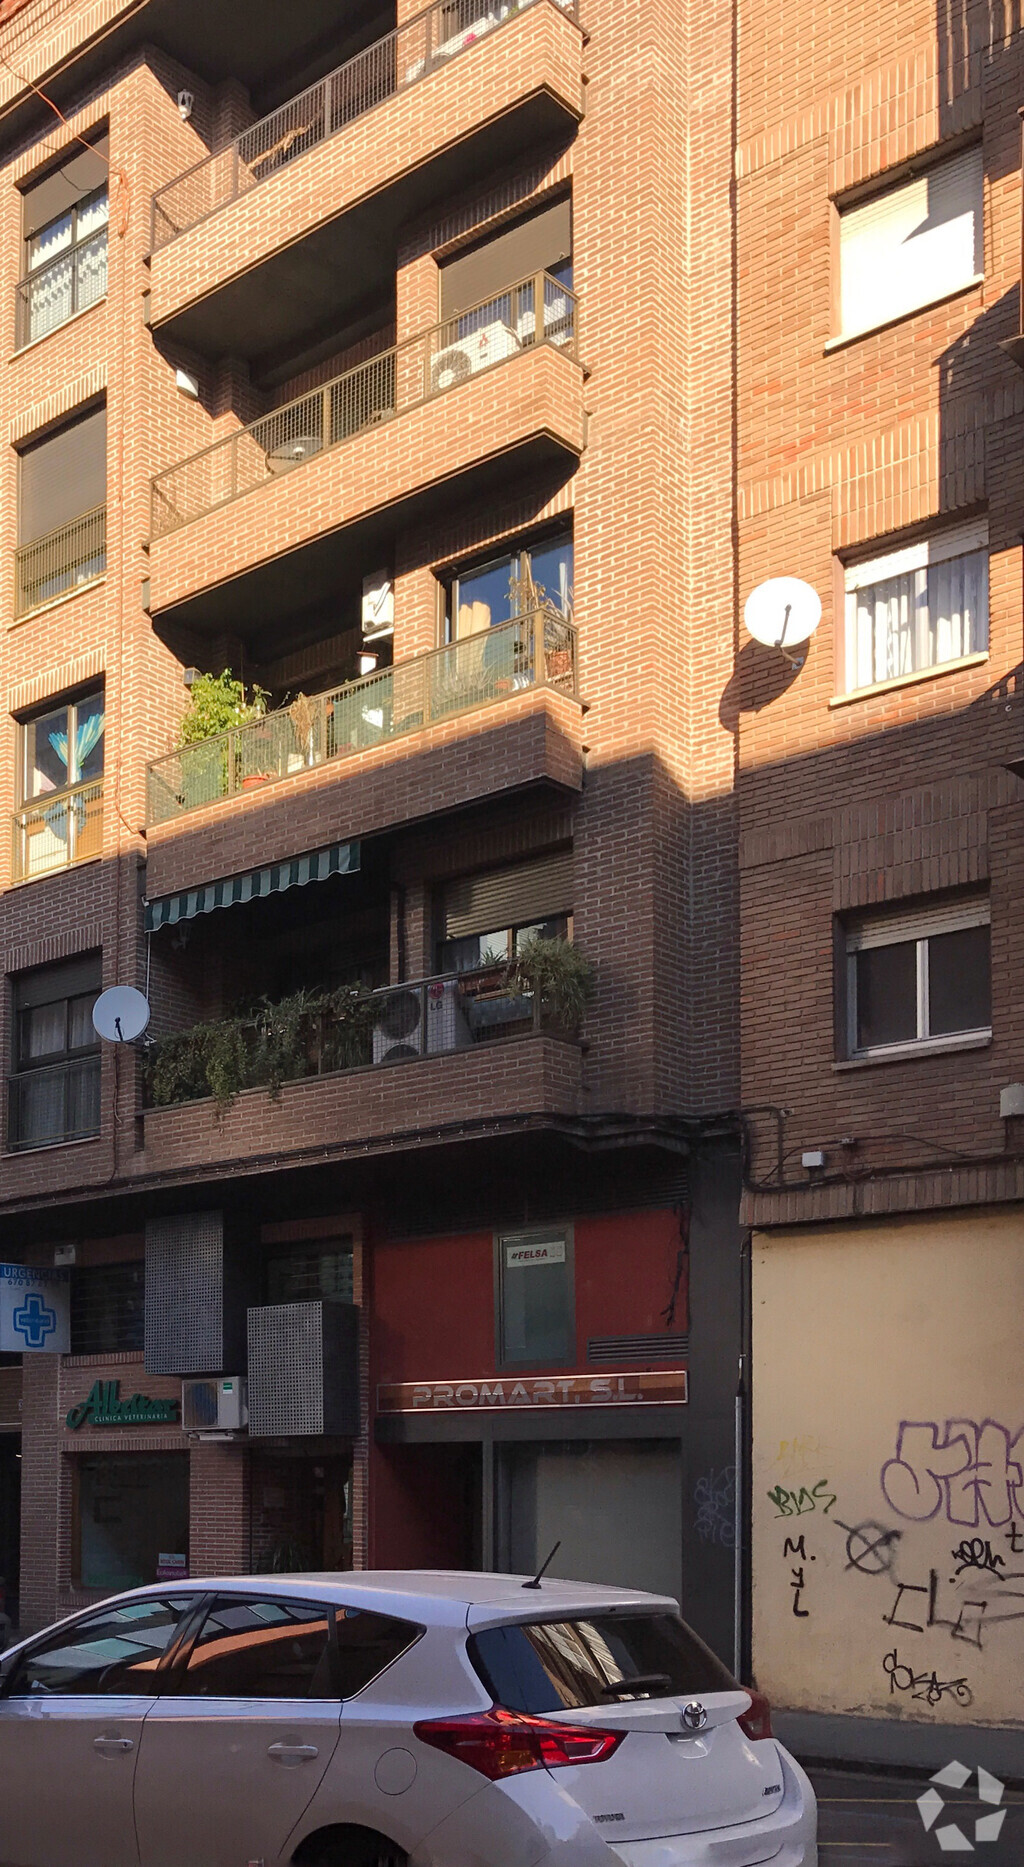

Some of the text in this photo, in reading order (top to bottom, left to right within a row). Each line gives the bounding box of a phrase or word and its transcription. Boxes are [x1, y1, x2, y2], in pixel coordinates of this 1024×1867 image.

[430, 1001, 443, 1010] LG
[3, 1266, 65, 1279] URGENCIAS
[589, 1377, 643, 1402] S.L.
